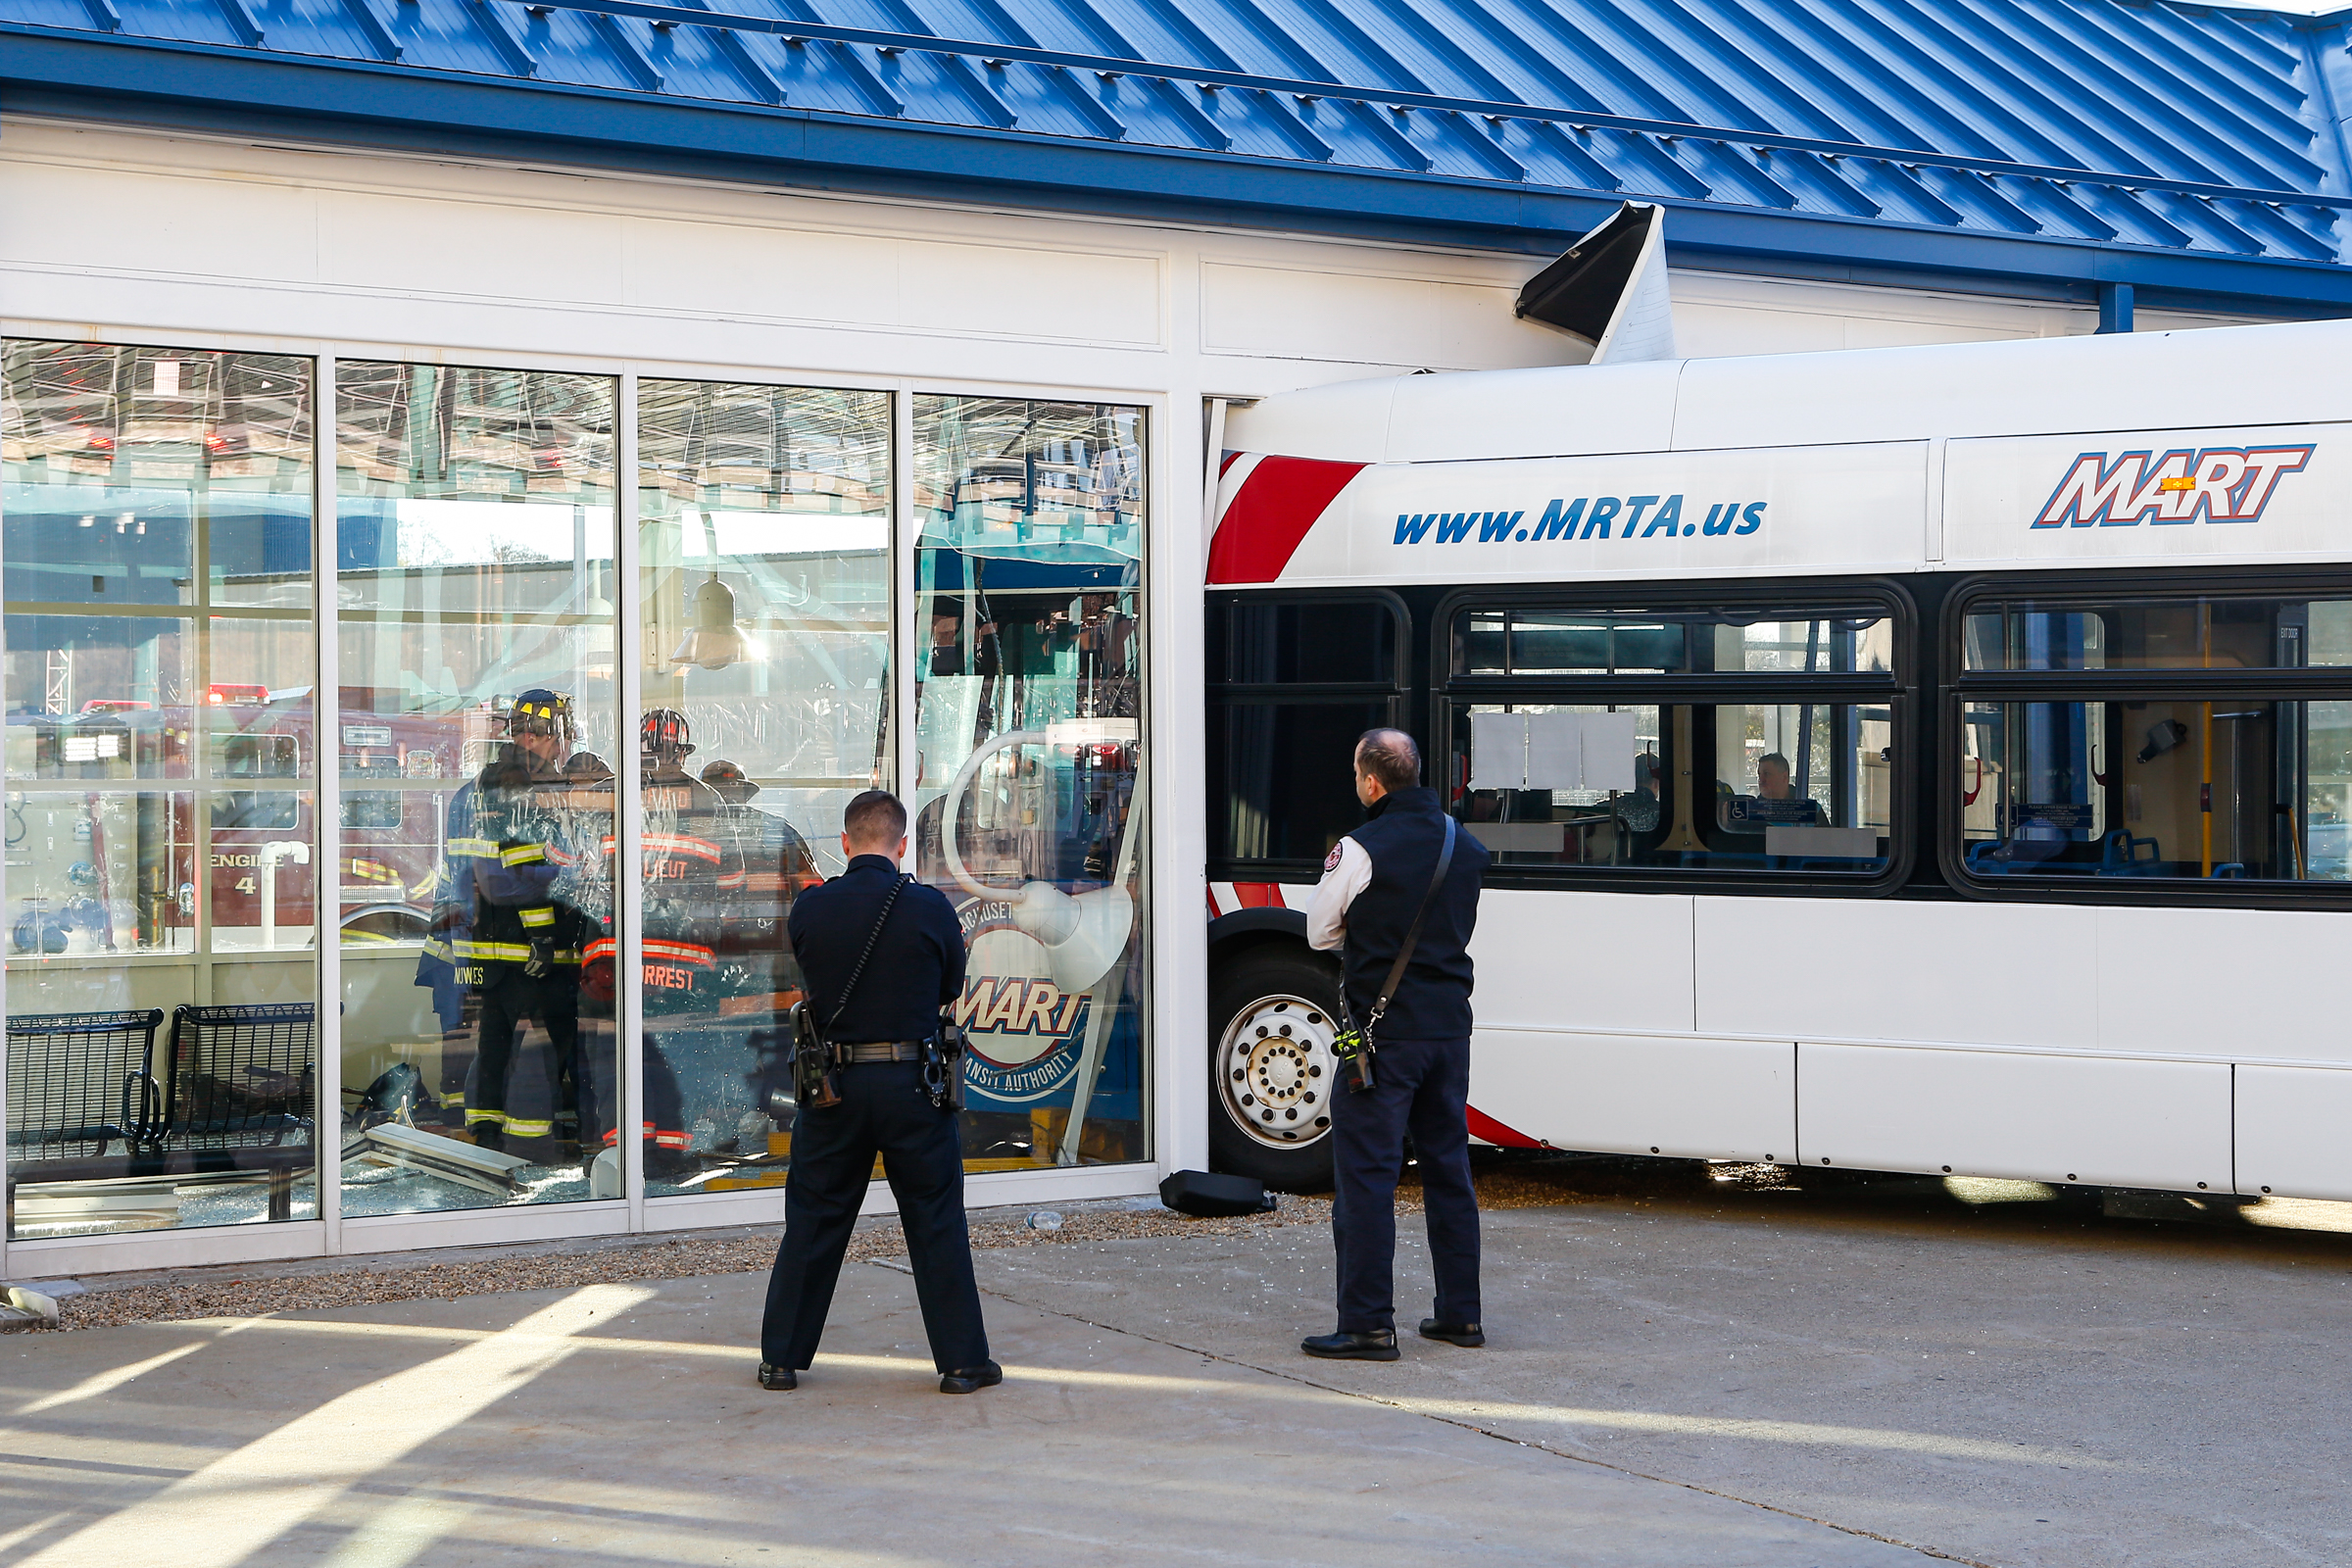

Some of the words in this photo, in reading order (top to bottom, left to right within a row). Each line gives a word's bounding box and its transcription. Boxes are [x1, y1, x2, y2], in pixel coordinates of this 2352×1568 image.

[2030, 443, 2318, 529] MART
[1393, 494, 1768, 546] www.MRTA.us
[234, 876, 257, 895] 4
[642, 965, 694, 990] RREST
[965, 1056, 999, 1089] ANSIT
[1004, 1051, 1073, 1092] AUTHORITY
